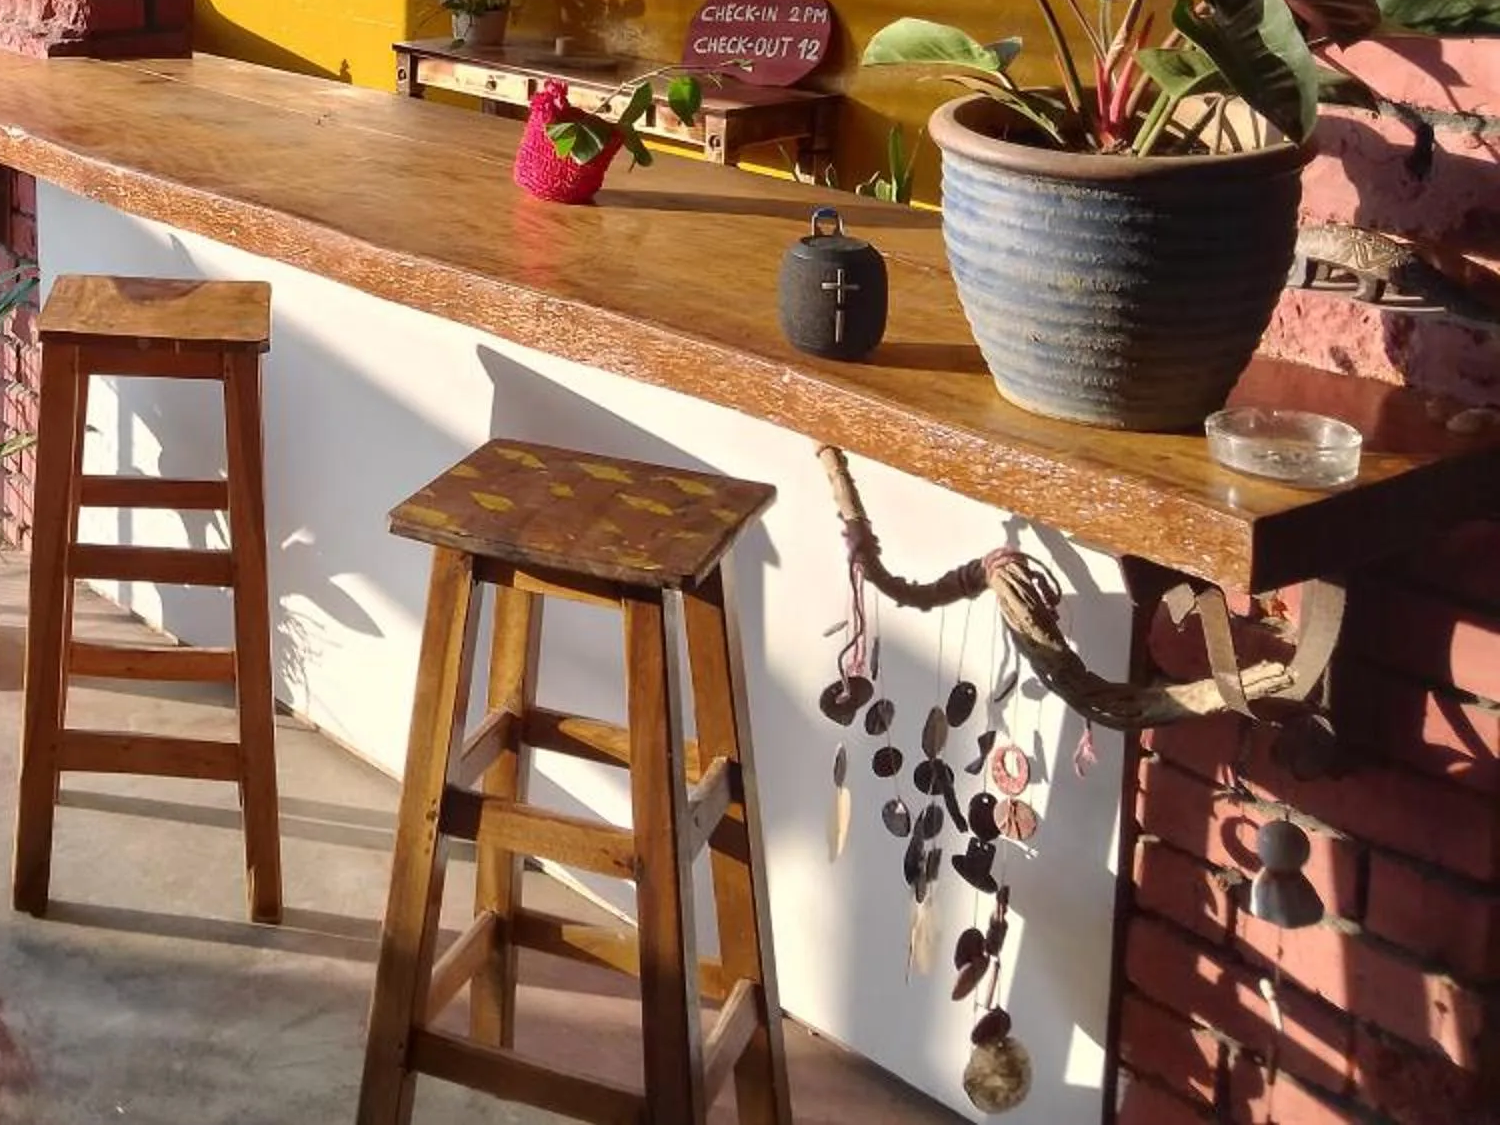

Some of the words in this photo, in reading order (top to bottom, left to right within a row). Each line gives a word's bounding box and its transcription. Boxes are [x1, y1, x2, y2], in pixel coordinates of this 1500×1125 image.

[701, 3, 778, 22] CHECK-IN
[693, 36, 794, 58] CHECK-OUT
[797, 38, 821, 60] 12
